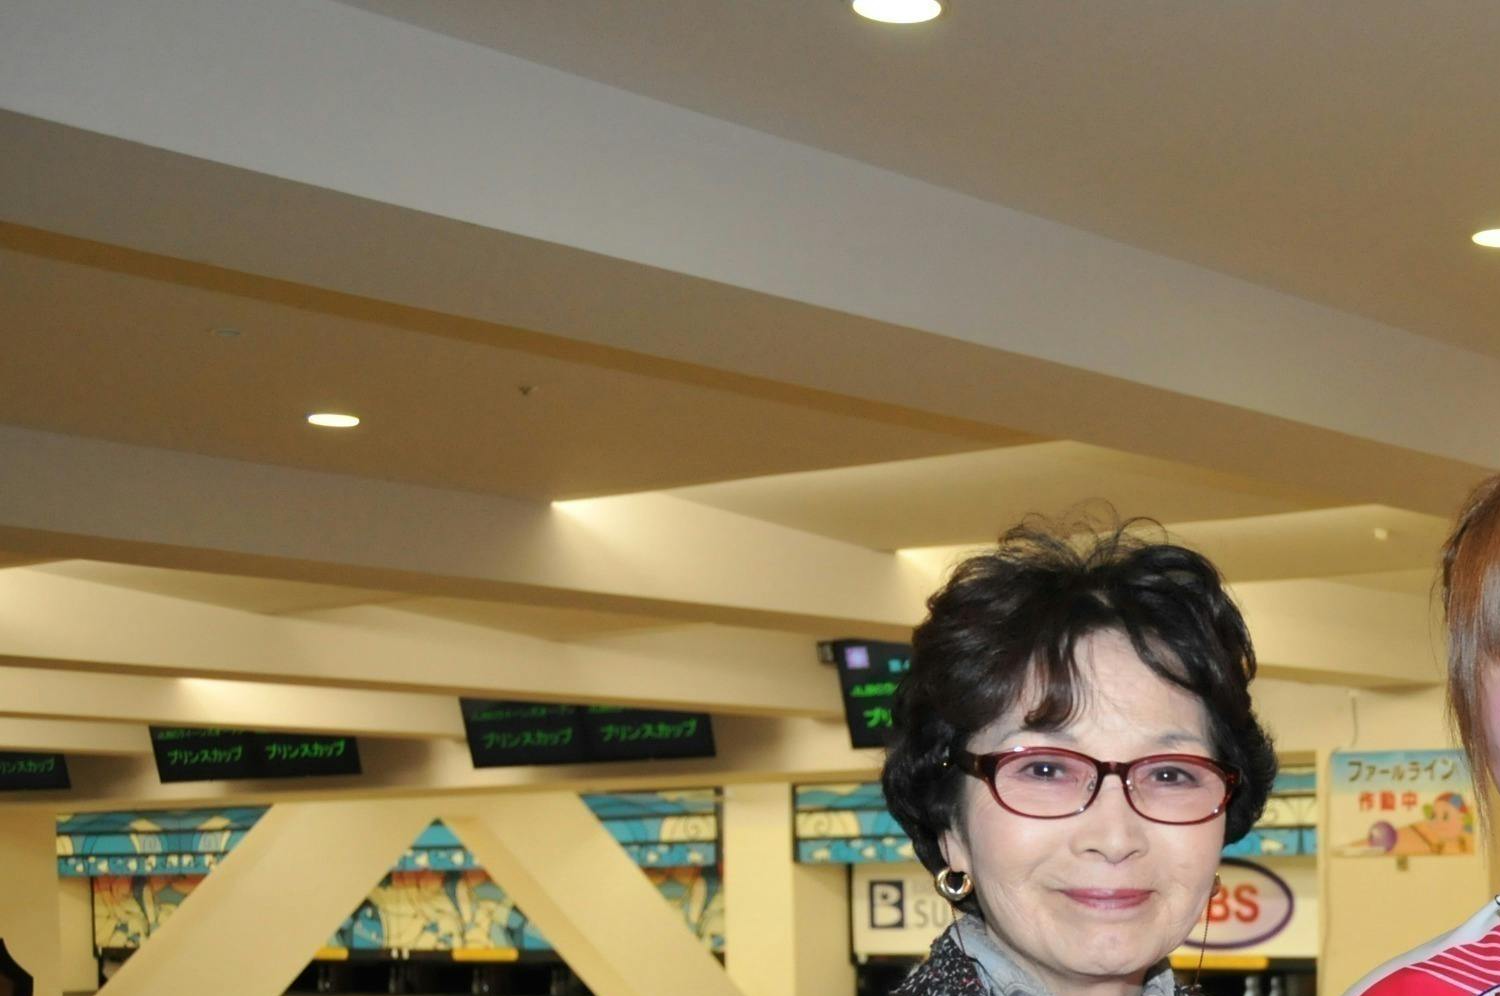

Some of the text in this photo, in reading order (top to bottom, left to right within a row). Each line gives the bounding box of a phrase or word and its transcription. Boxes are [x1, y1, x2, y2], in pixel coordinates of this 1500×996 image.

[1347, 758, 1457, 783] ファールライン
[1200, 883, 1260, 924] BS
